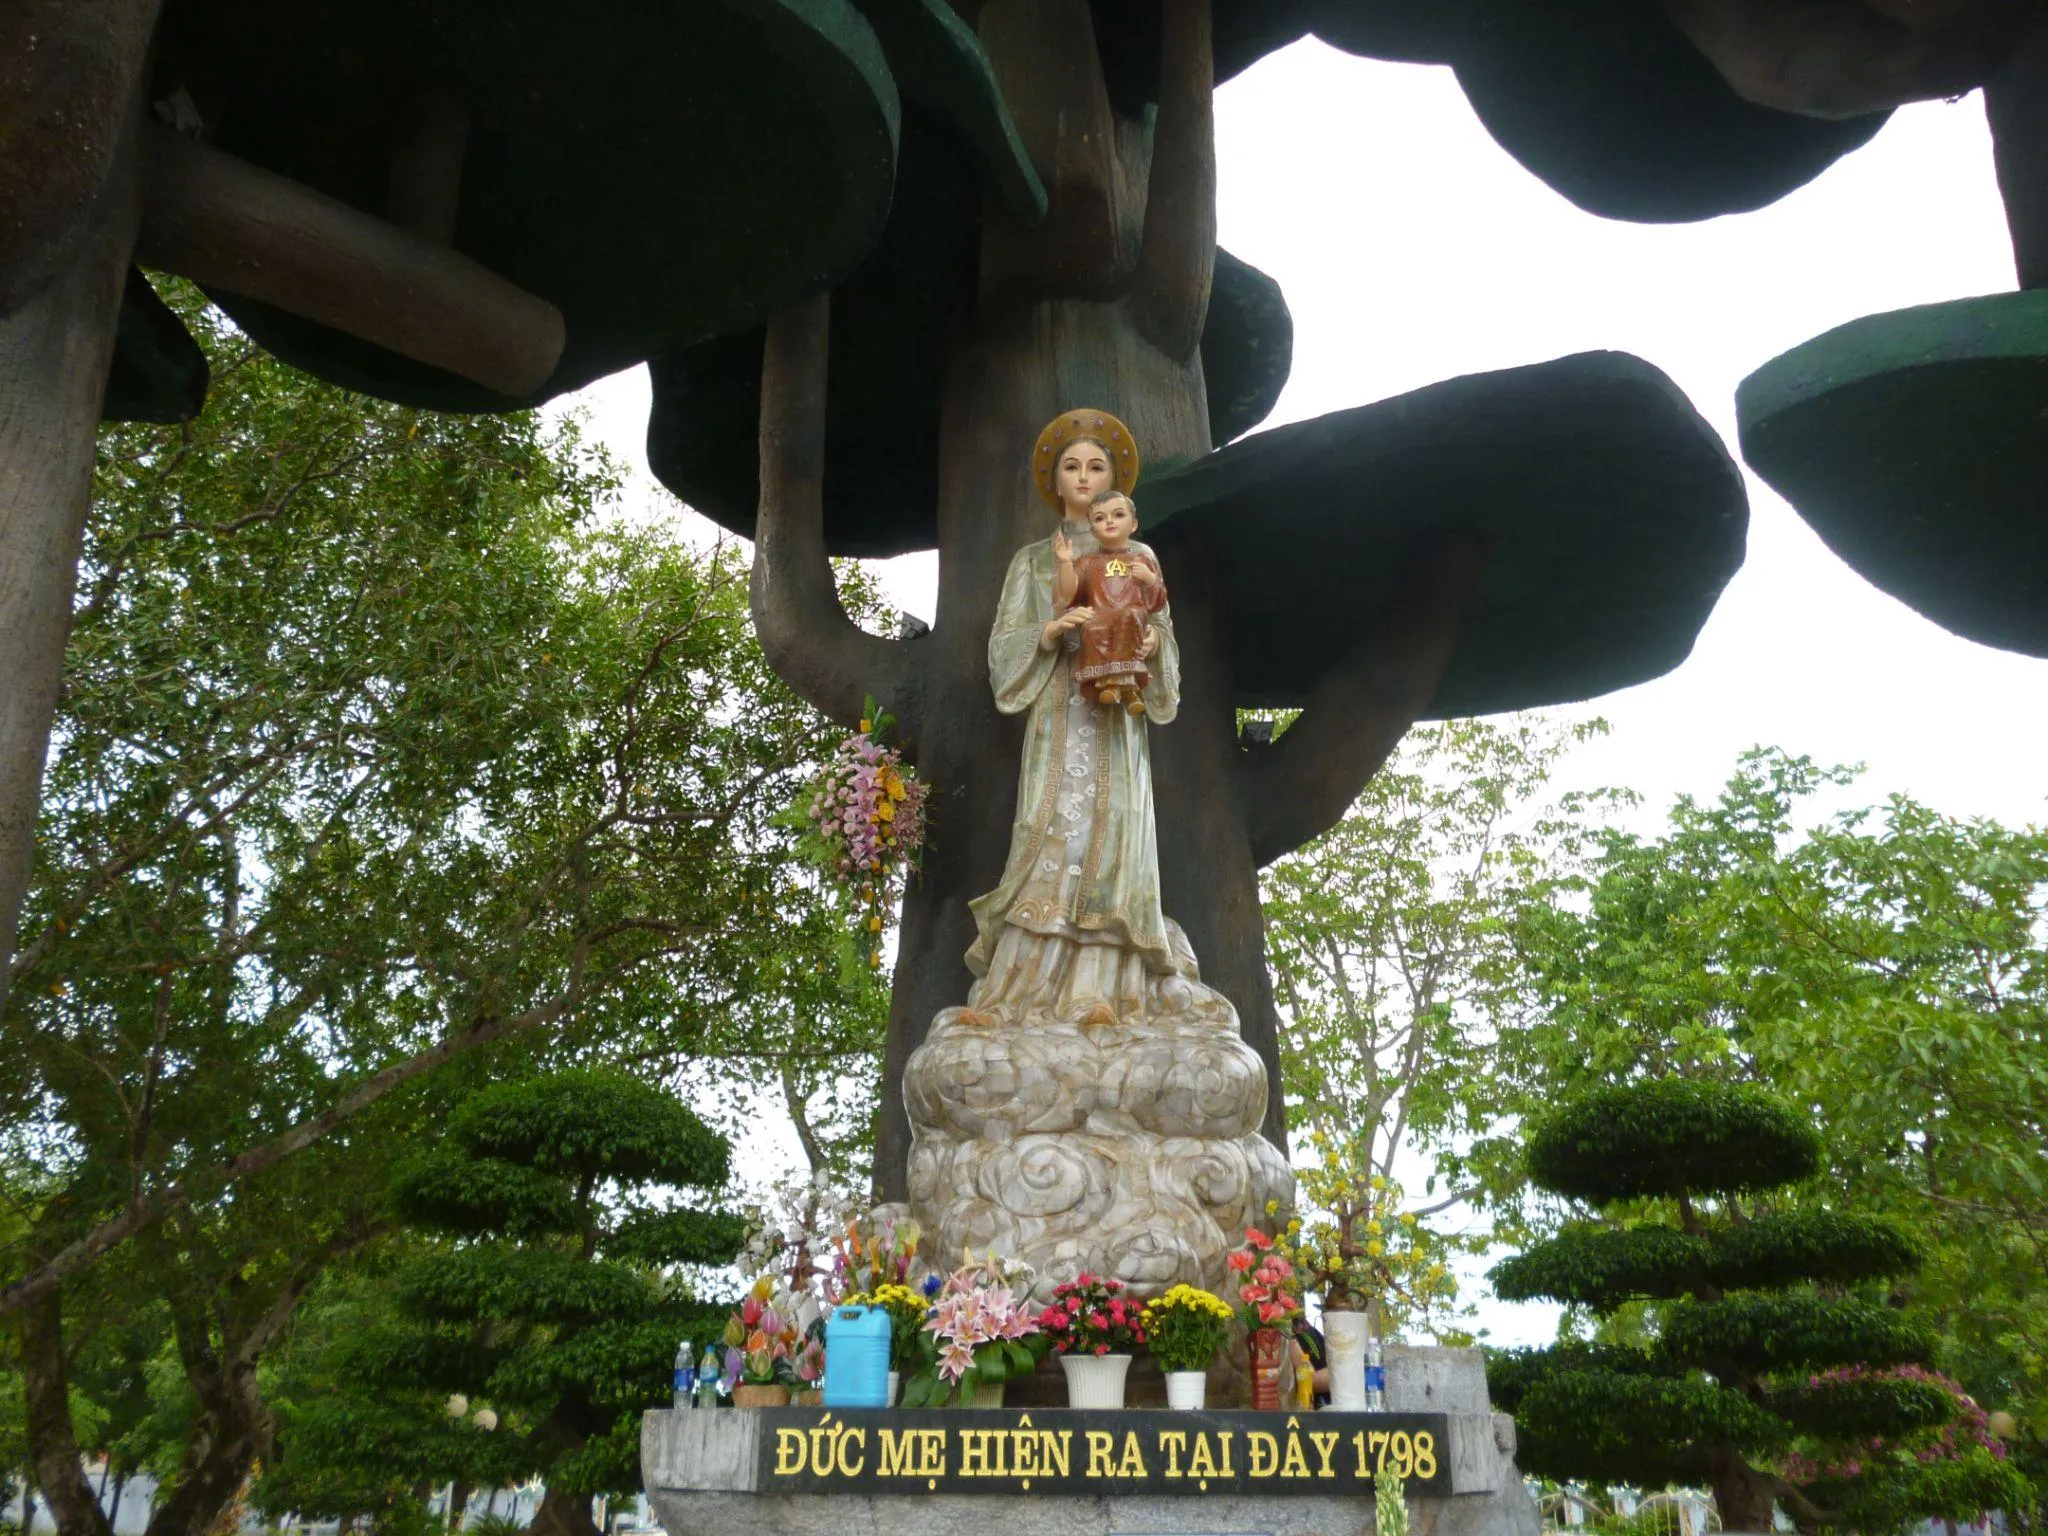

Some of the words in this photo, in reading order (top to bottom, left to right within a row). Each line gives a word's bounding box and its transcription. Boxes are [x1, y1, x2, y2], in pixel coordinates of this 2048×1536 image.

[774, 1412, 865, 1477] ĐỨC
[876, 1428, 946, 1490] MẸ
[958, 1413, 1072, 1490] HIỆN
[1085, 1431, 1148, 1477] RA
[1159, 1431, 1235, 1491] TẠI
[1247, 1415, 1340, 1477] ĐÂY
[1352, 1431, 1437, 1479] 1798
